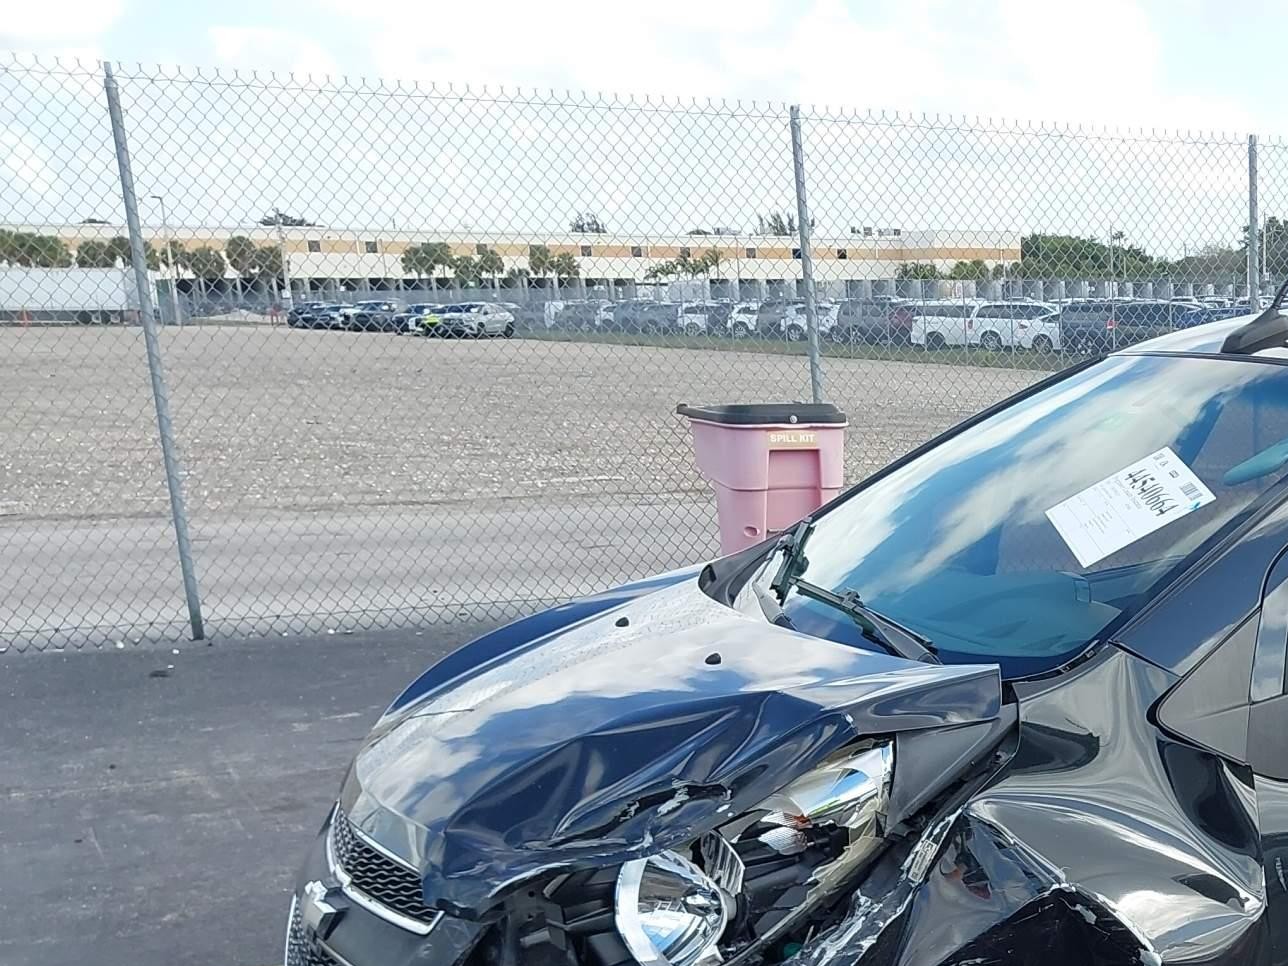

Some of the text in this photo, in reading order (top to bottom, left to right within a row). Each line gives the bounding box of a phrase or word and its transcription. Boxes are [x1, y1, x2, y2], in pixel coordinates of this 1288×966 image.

[769, 433, 816, 443] SPILL KIT
[1124, 468, 1180, 517] 44540664
